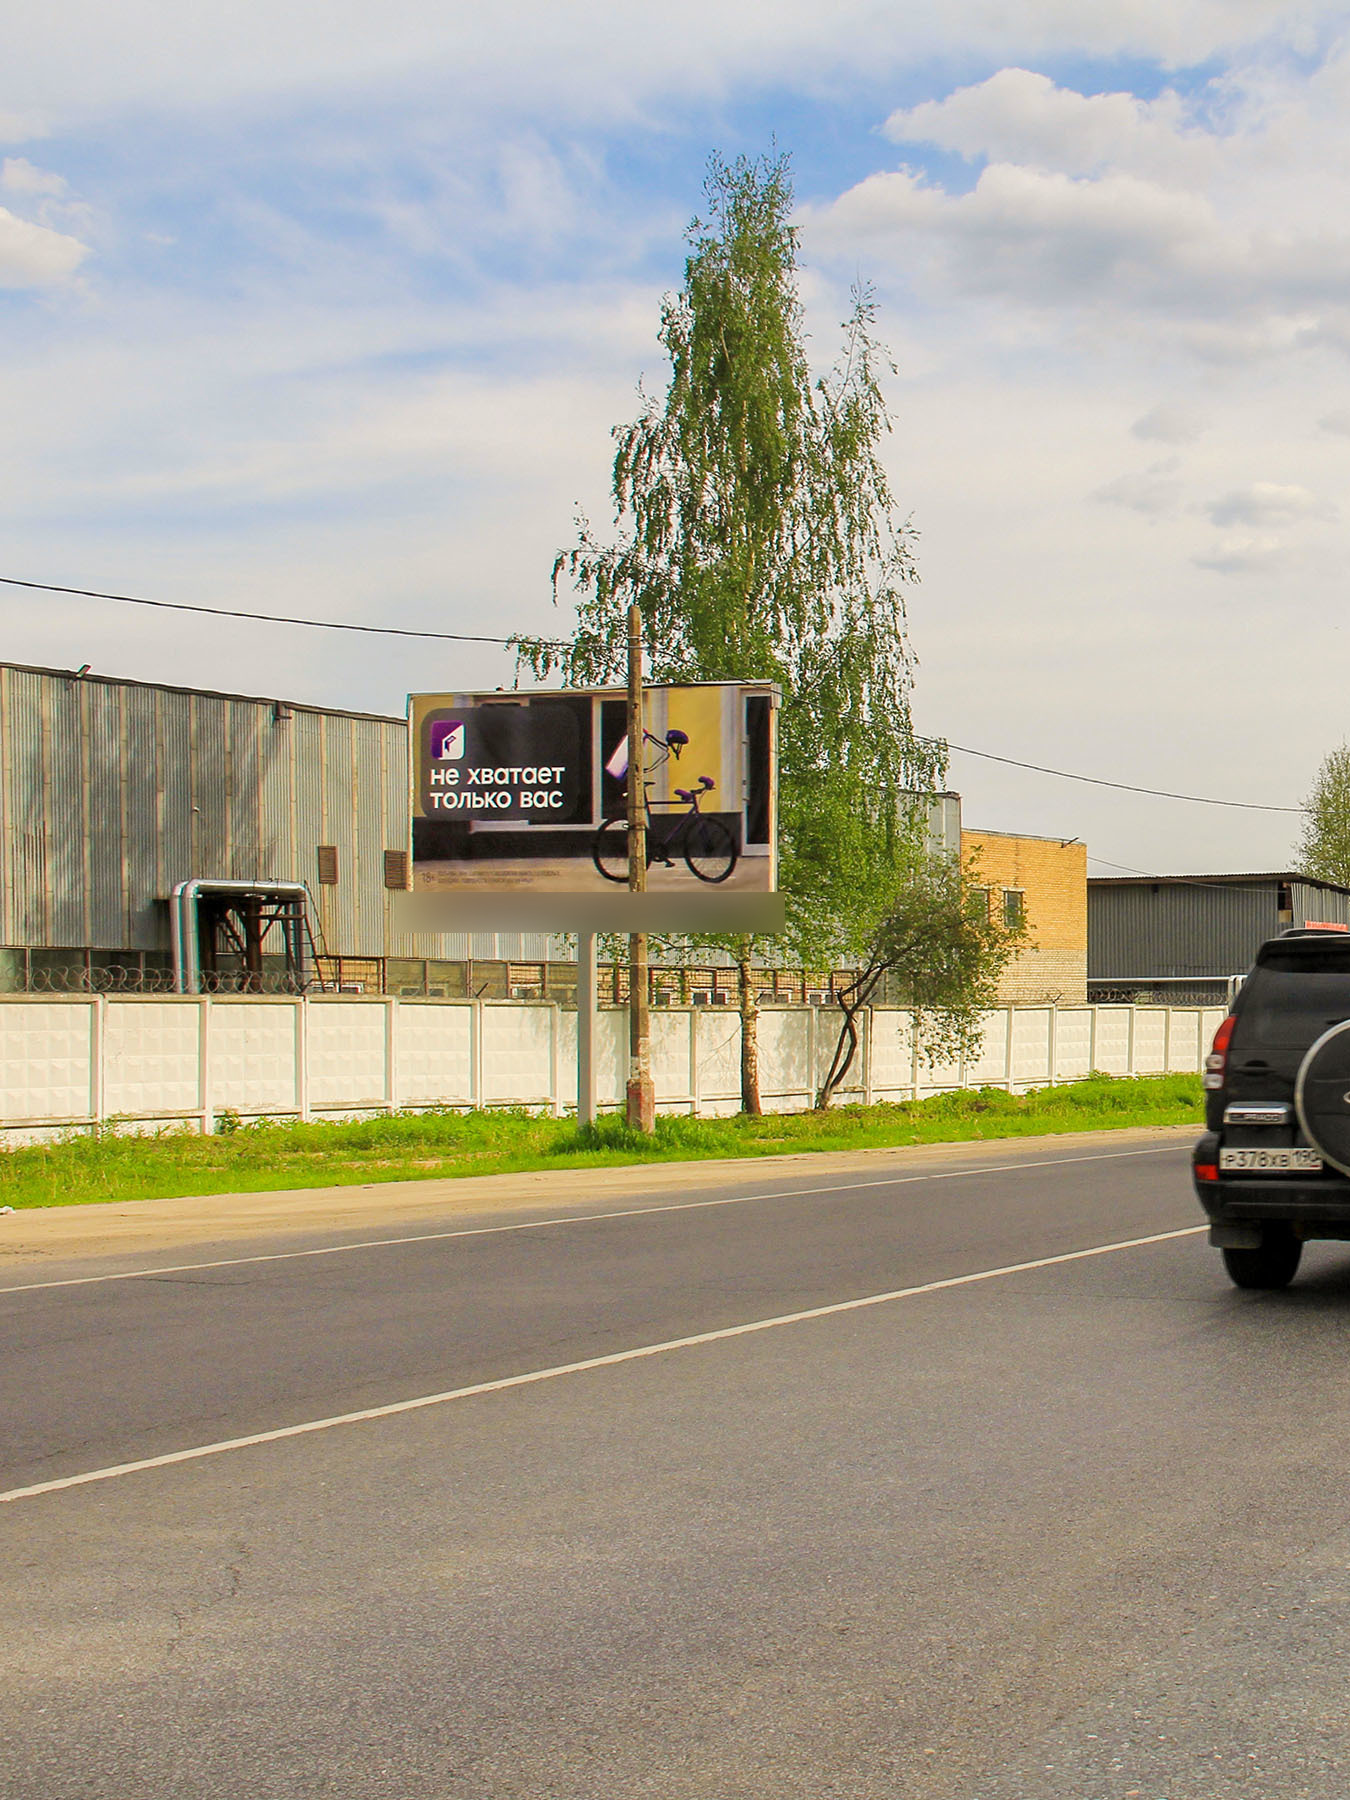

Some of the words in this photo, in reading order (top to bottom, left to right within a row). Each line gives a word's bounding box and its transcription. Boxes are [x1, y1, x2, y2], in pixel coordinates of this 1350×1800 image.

[430, 768, 460, 786] не
[467, 766, 566, 785] хватает
[429, 791, 512, 809] только
[520, 790, 563, 808] вас
